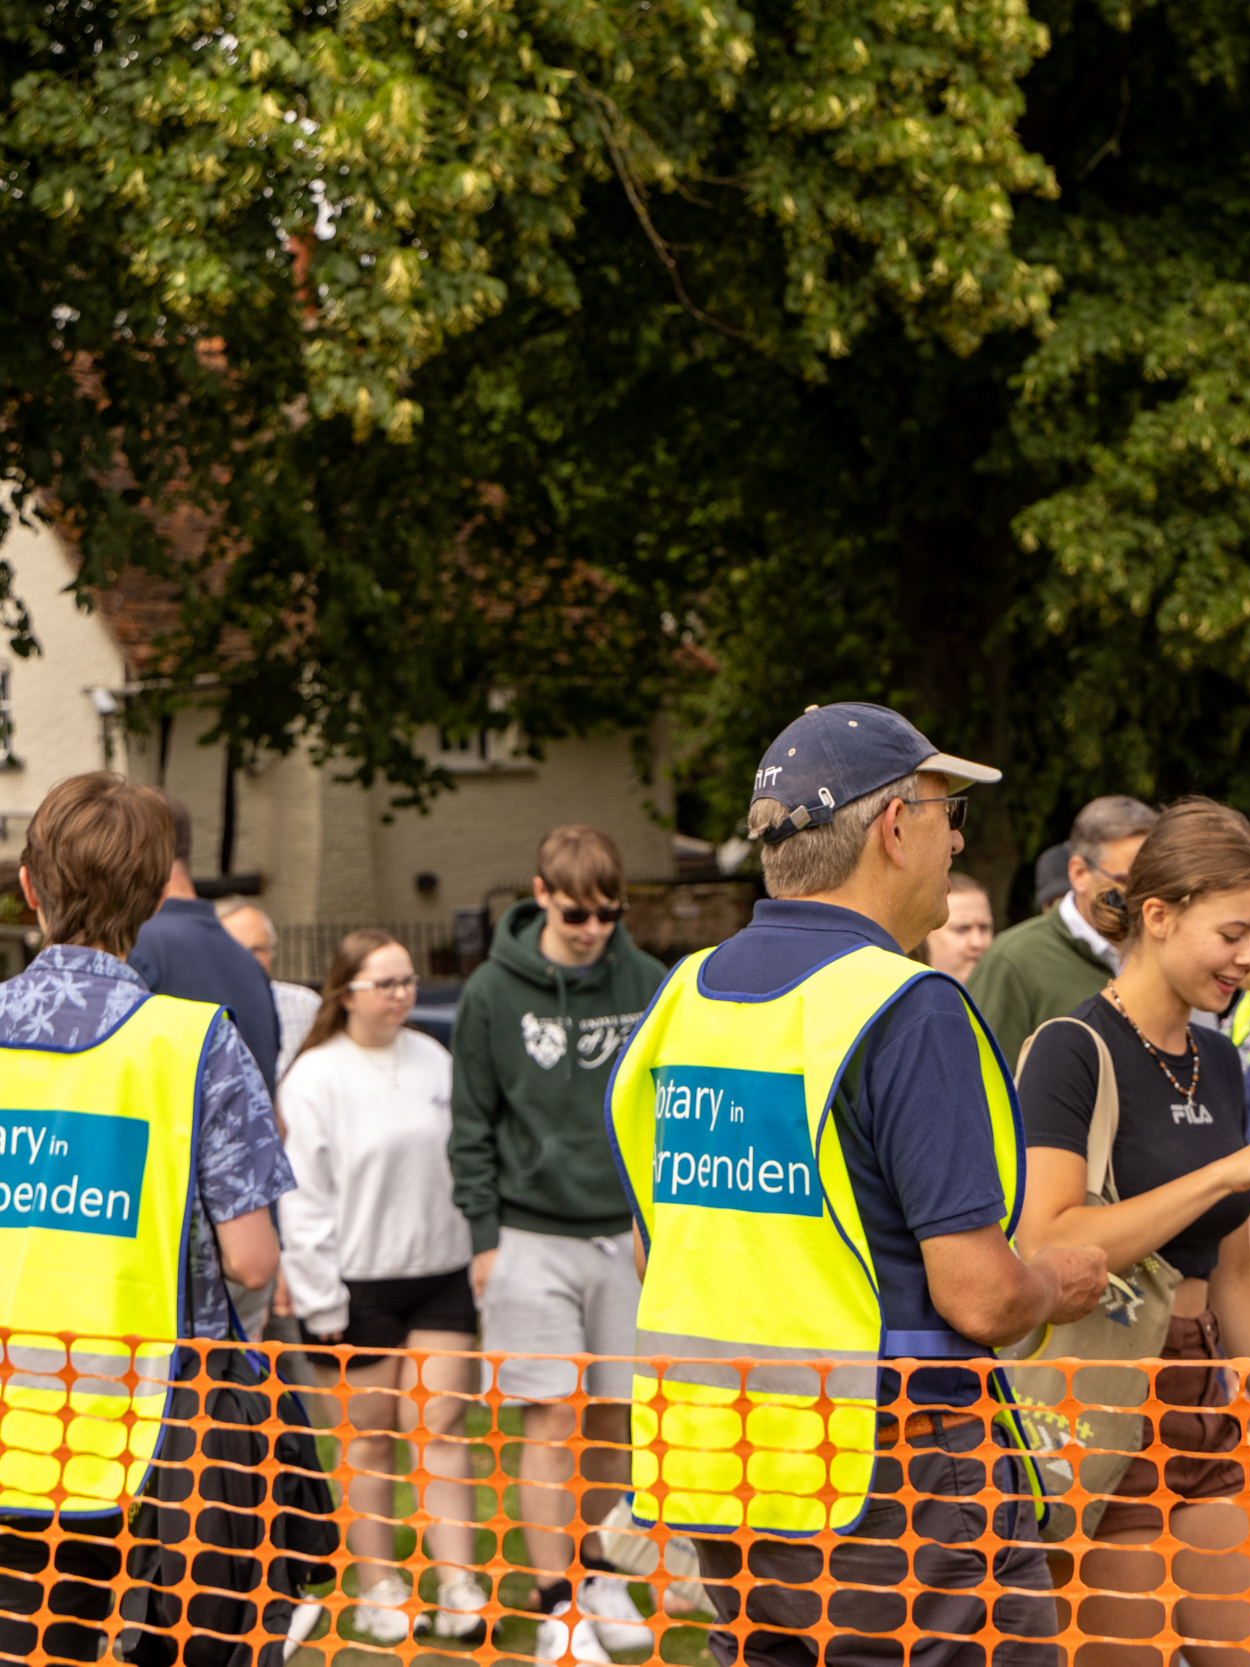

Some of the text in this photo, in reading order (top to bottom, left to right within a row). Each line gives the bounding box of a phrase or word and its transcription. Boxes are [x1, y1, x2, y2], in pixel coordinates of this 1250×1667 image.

[730, 1100, 744, 1124] in
[1170, 1103, 1214, 1125] FILA
[49, 1134, 69, 1157] in
